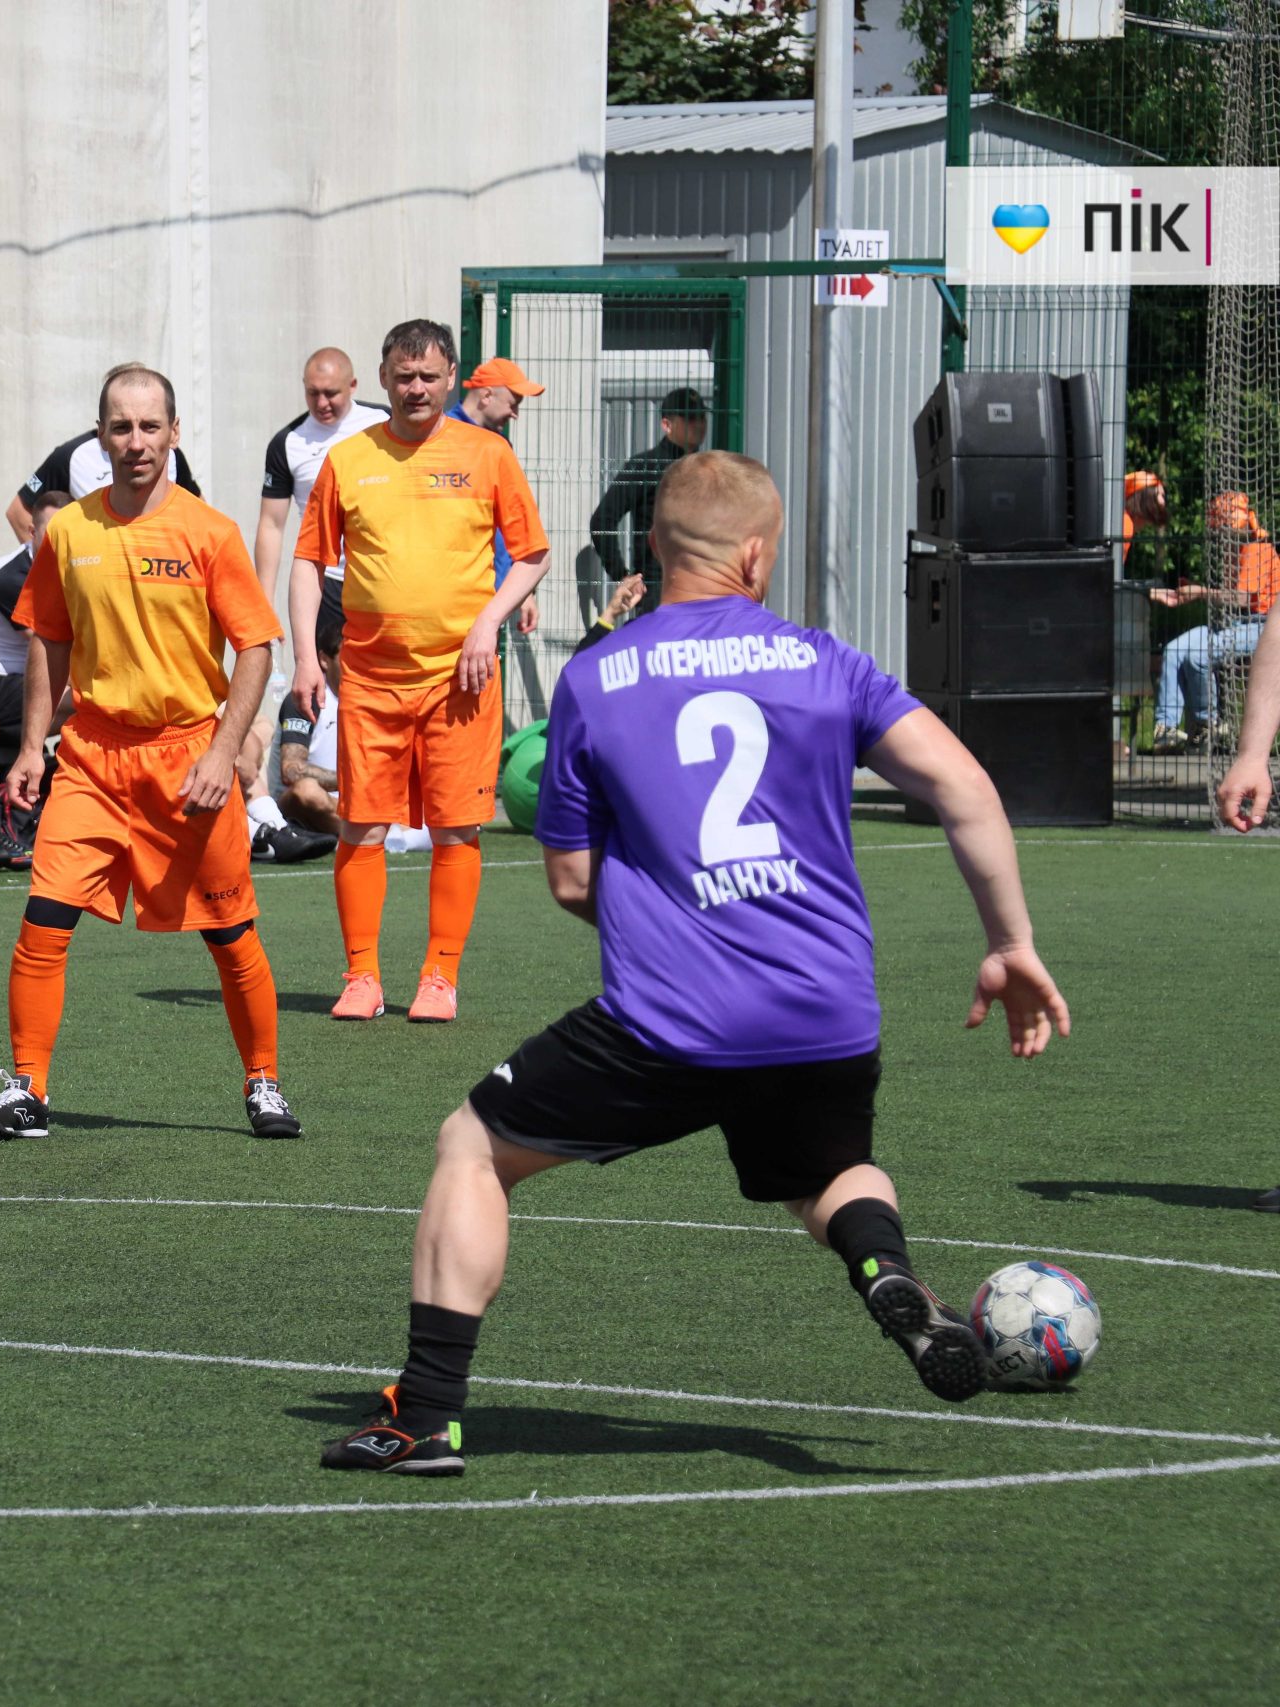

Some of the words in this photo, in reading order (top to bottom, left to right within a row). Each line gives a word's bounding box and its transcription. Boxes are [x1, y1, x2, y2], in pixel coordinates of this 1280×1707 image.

[821, 239, 883, 260] ТУАЛЕТ
[599, 646, 640, 693] ШУ
[675, 691, 781, 867] 2
[213, 887, 239, 901] SECO
[691, 859, 808, 910] ЛАНТУК
[988, 1350, 1028, 1378] LECT
